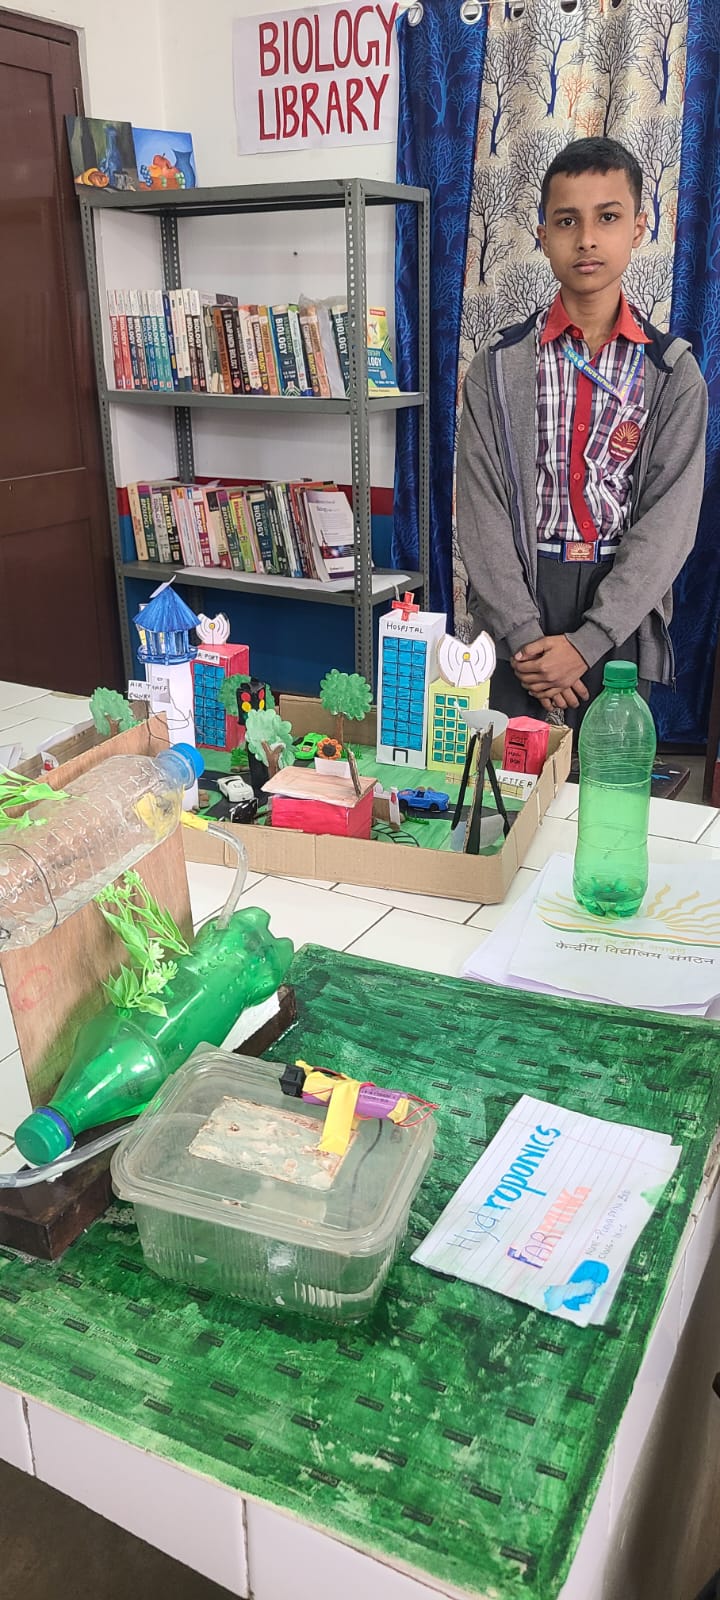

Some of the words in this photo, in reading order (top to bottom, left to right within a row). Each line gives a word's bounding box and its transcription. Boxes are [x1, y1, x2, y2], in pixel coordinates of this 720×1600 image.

[259, 2, 399, 76] BIOLOGY
[259, 73, 389, 140] LIBRARY
[127, 316, 136, 345] BIOLOGY
[133, 316, 143, 347] BIOLOGY
[151, 316, 160, 347] BIOLOGY
[158, 316, 168, 347] BIOLOGY
[193, 318, 202, 348] BIOLOGY
[275, 318, 288, 354] BIOLOGY
[335, 317, 348, 354] BIOLOGY
[162, 495, 174, 534] BIOLOGY
[253, 504, 264, 536] BIOLOGY
[386, 622, 424, 634] HOSPITAL
[497, 775, 533, 788] LETTER
[605, 944, 662, 960] विद्यालय
